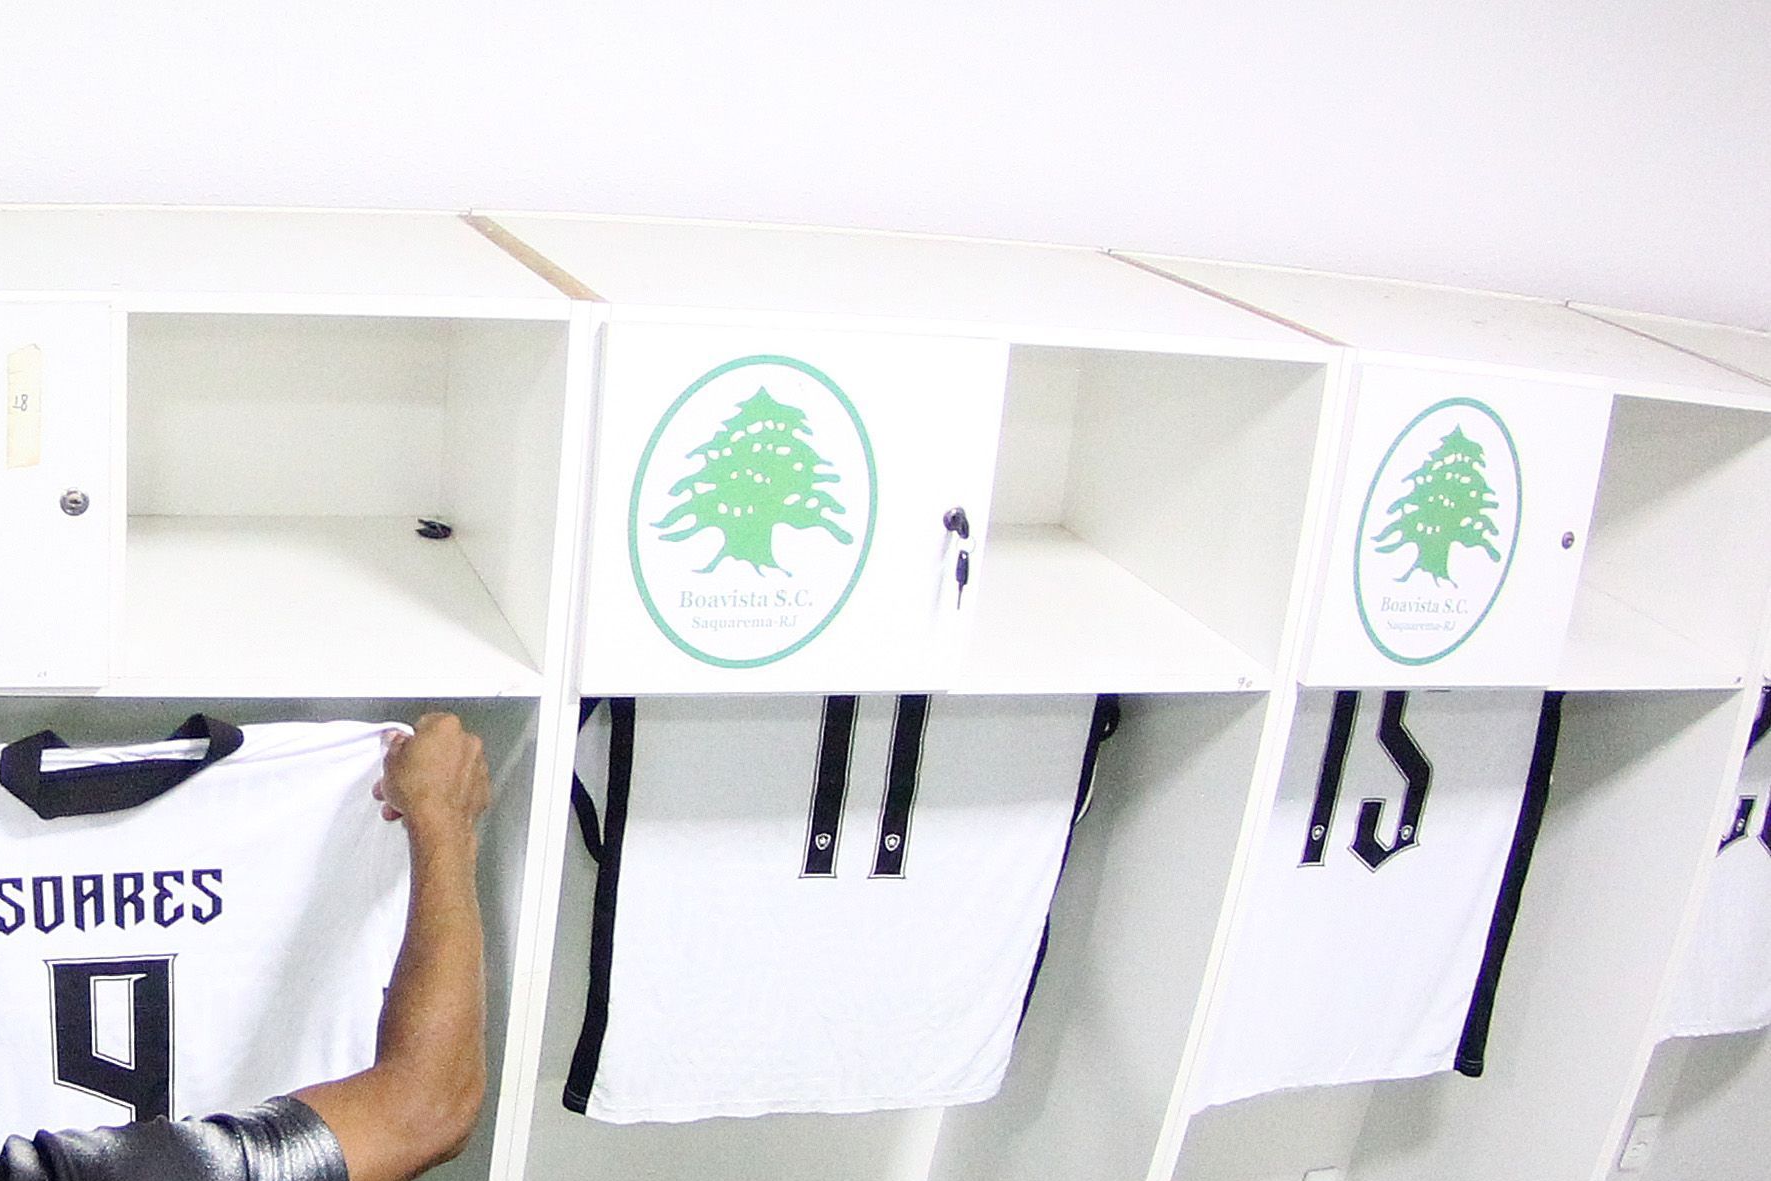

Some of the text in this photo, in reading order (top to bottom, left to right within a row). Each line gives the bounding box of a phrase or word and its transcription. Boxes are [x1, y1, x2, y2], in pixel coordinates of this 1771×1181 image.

[678, 588, 813, 608] Boavista S.C.
[1380, 596, 1468, 614] Boavista S.C.
[691, 614, 797, 632] Saquarema-RJ
[798, 695, 932, 880] 11
[43, 953, 178, 1122] 9
